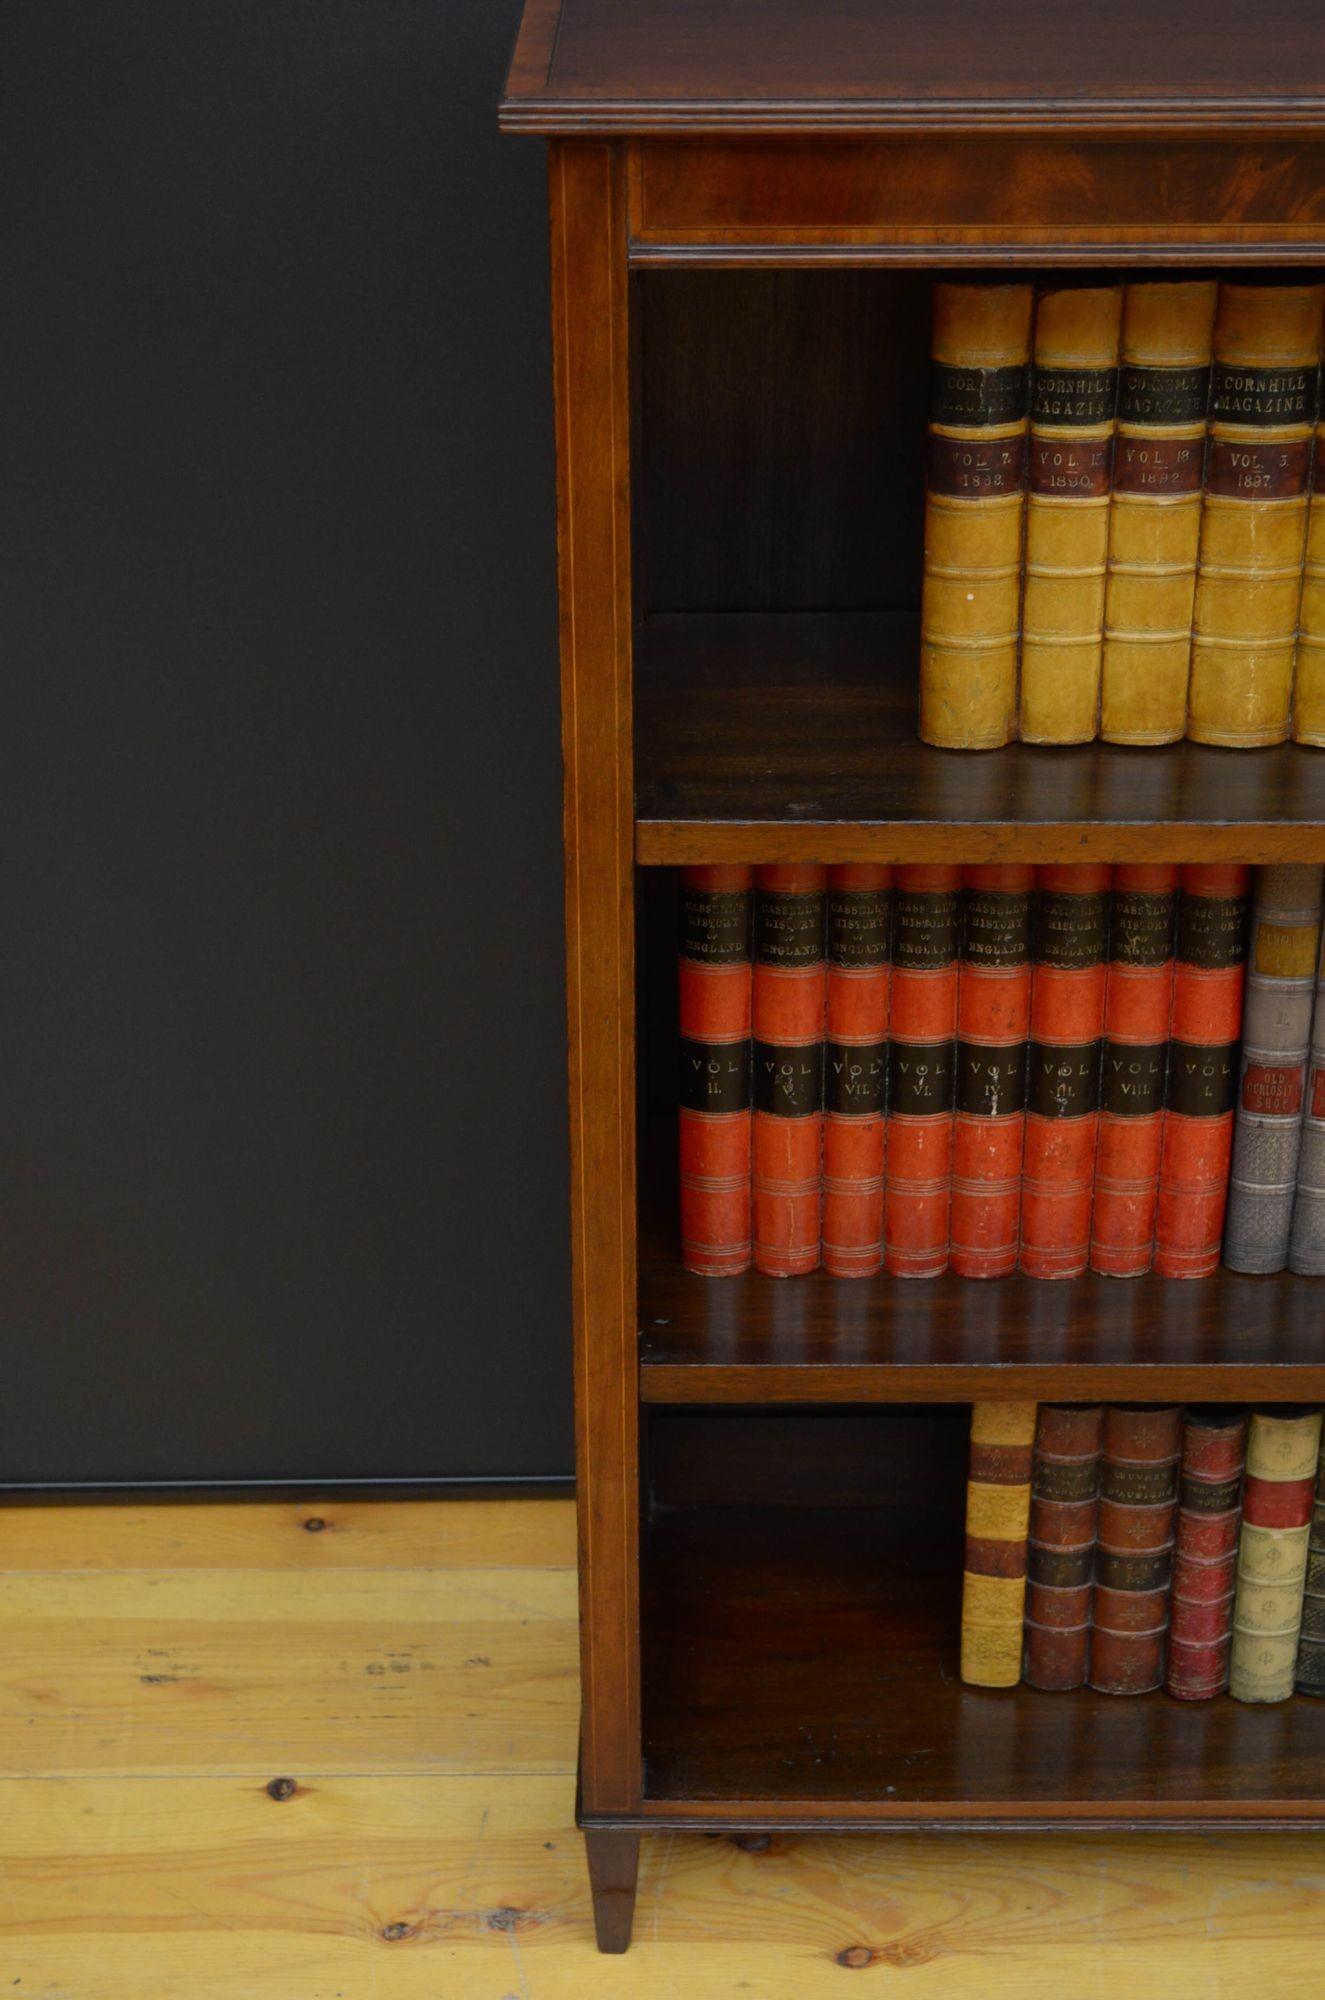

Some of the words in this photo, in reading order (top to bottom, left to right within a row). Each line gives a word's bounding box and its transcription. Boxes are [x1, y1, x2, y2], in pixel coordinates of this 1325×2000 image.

[1036, 378, 1112, 394] CORNHILL
[1224, 375, 1306, 393] CORNHILL
[1218, 395, 1304, 413] MAGAZINE
[968, 941, 1025, 955] ENGLAND
[1264, 1072, 1287, 1084] OLD
